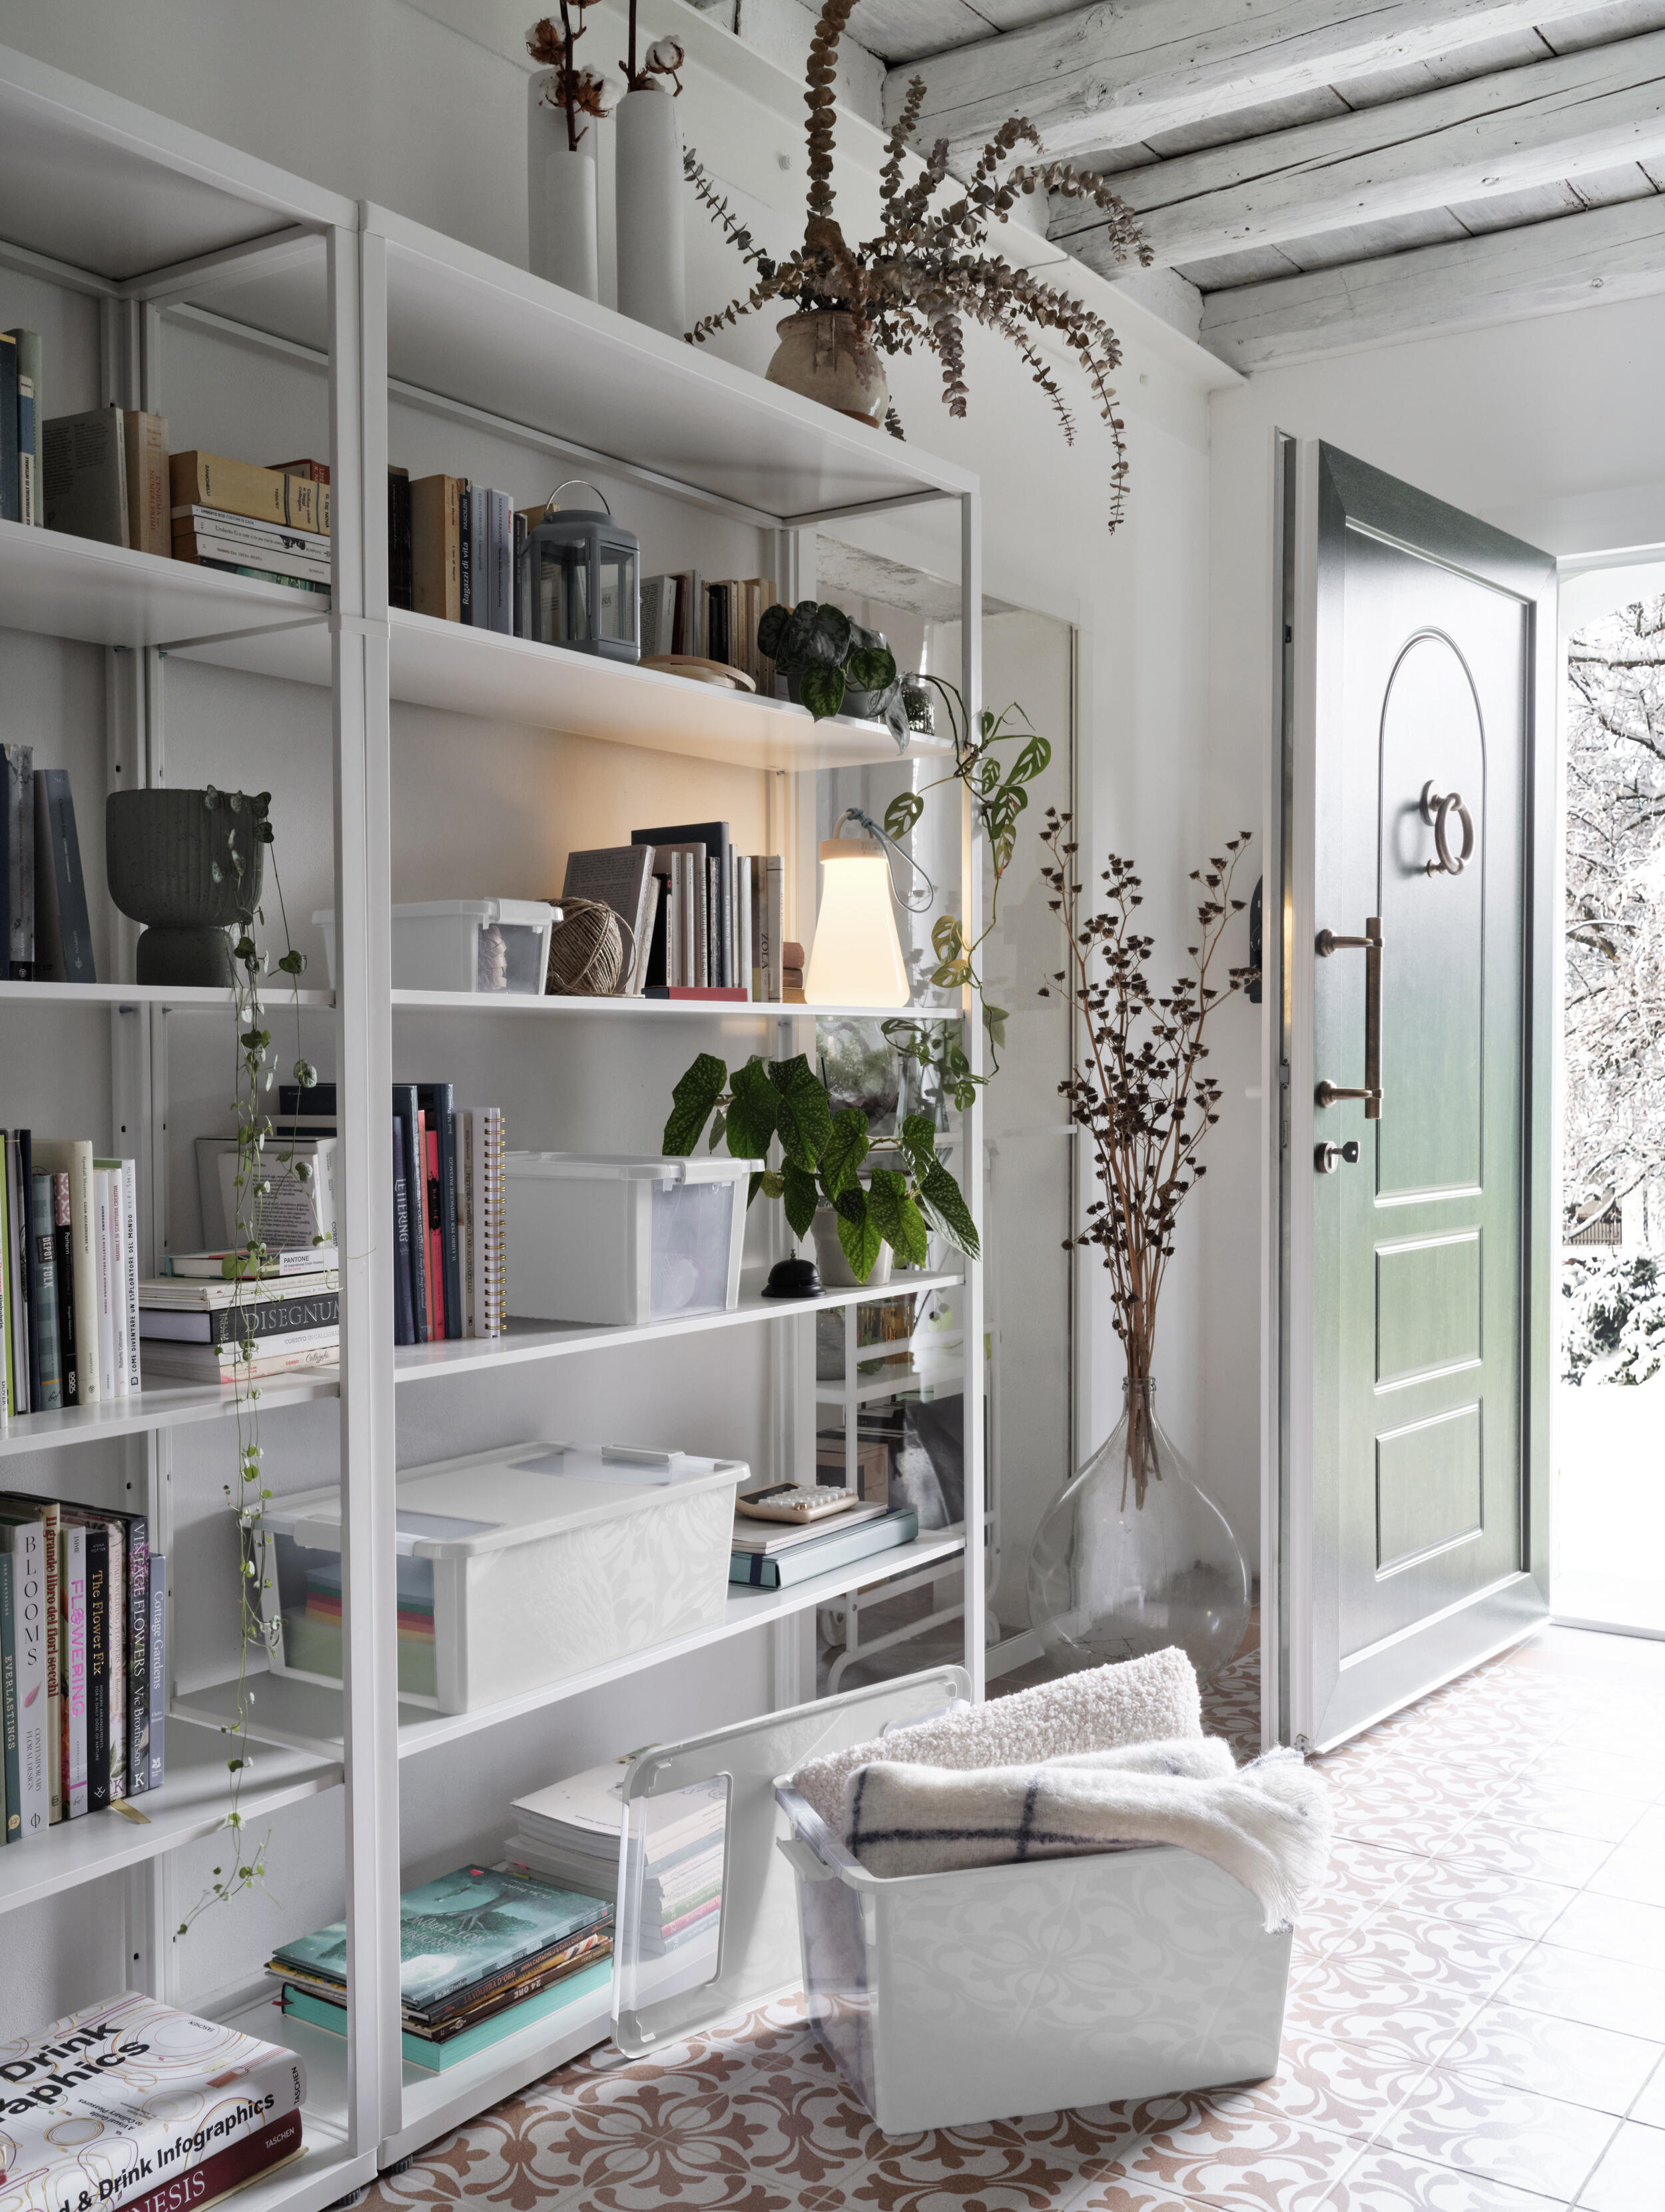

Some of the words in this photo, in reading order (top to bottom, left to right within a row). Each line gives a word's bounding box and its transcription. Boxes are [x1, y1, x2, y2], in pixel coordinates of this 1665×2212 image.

[462, 558, 469, 569] di
[394, 1178, 409, 1242] LETTERING
[43, 1237, 53, 1260] DEPOT
[467, 1238, 472, 1248] AD
[283, 1255, 309, 1264] PANTONE
[43, 1265, 53, 1288] FOLK
[130, 1304, 135, 1313] UN
[284, 1336, 306, 1345] CORSIVO
[46, 1516, 57, 1526] Il
[43, 1529, 58, 1572] grande
[133, 1523, 145, 1597] VINTAGE
[47, 1573, 59, 1605] libro
[93, 1570, 103, 1598] The
[24, 1535, 39, 1666] BLOOMS
[47, 1605, 58, 1629] dei
[93, 1601, 104, 1649] Flower
[152, 1591, 164, 1637] Cottage
[47, 1629, 59, 1656] fiori
[71, 1579, 84, 1717] FLOWERING
[134, 1599, 145, 1677] FLOWERS
[93, 1651, 105, 1676] Fix
[153, 1639, 164, 1689] Gardens
[47, 1657, 59, 1699] secchi
[5, 1654, 15, 1750] EVERLASTINGS
[134, 1686, 144, 1705] Vic
[134, 1707, 144, 1767] Brotherson
[134, 1773, 145, 1787] K
[520, 1962, 533, 1972] ANNA
[533, 1948, 556, 1967] CASTAGNOLI
[472, 1978, 498, 2000] VOLIERA
[496, 1970, 517, 1986] D'ORO
[513, 1986, 529, 2000] ORE
[530, 1978, 542, 1990] 24
[189, 2020, 216, 2033] TASCHEN
[0, 2022, 125, 2083] Drink
[291, 2066, 300, 2105] TASCHEN
[77, 2098, 109, 2115] Pleasures
[89, 2111, 109, 2123] Guide
[109, 2110, 136, 2125] Culinary
[109, 2117, 129, 2129] Visual
[264, 2127, 295, 2148] TASCHEN
[78, 2191, 93, 2212] &
[99, 2157, 153, 2201] Drink
[157, 2093, 274, 2169] Infographics
